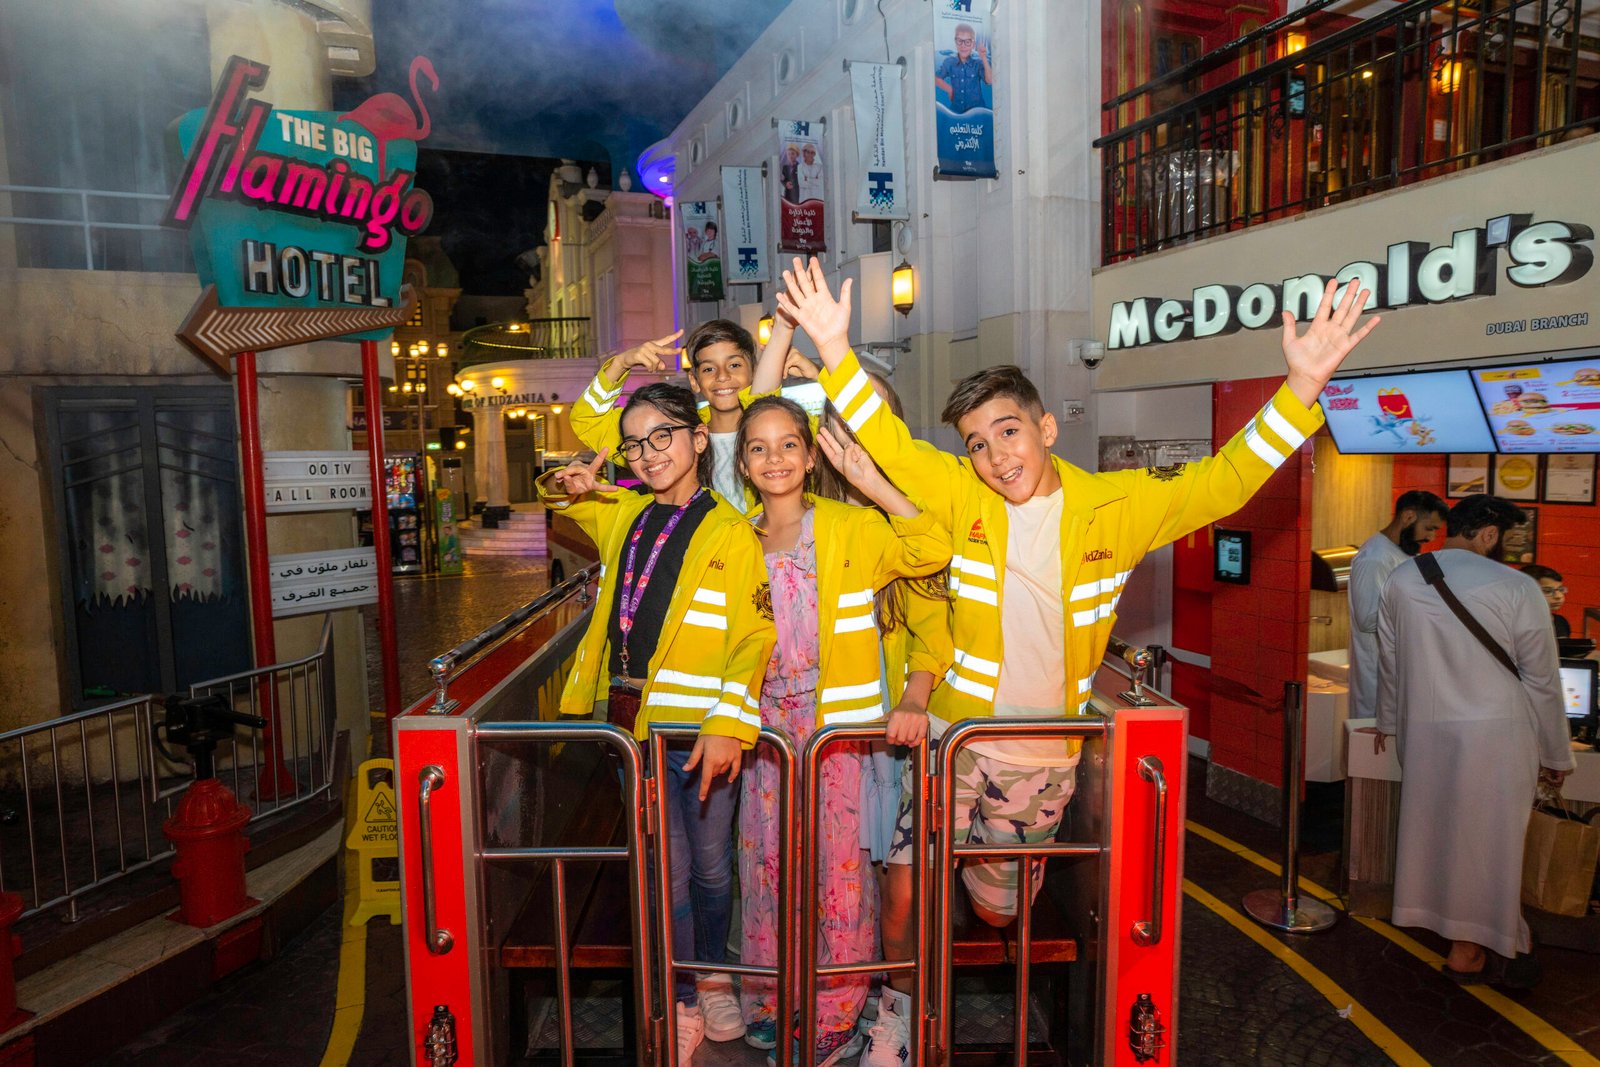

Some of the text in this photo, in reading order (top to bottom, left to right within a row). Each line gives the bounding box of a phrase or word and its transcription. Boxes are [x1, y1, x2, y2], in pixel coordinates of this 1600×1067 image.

[275, 112, 374, 164] THE BIG
[160, 55, 434, 253] Flamingo
[242, 238, 393, 308] HOTEL
[1107, 216, 1594, 350] McDonald's
[1486, 313, 1588, 335] DUBAI BRANCH
[488, 392, 545, 406] KIDZANIA
[275, 487, 366, 502] ALL ROOM
[279, 565, 303, 579] في
[282, 584, 369, 602] جميع الغرف
